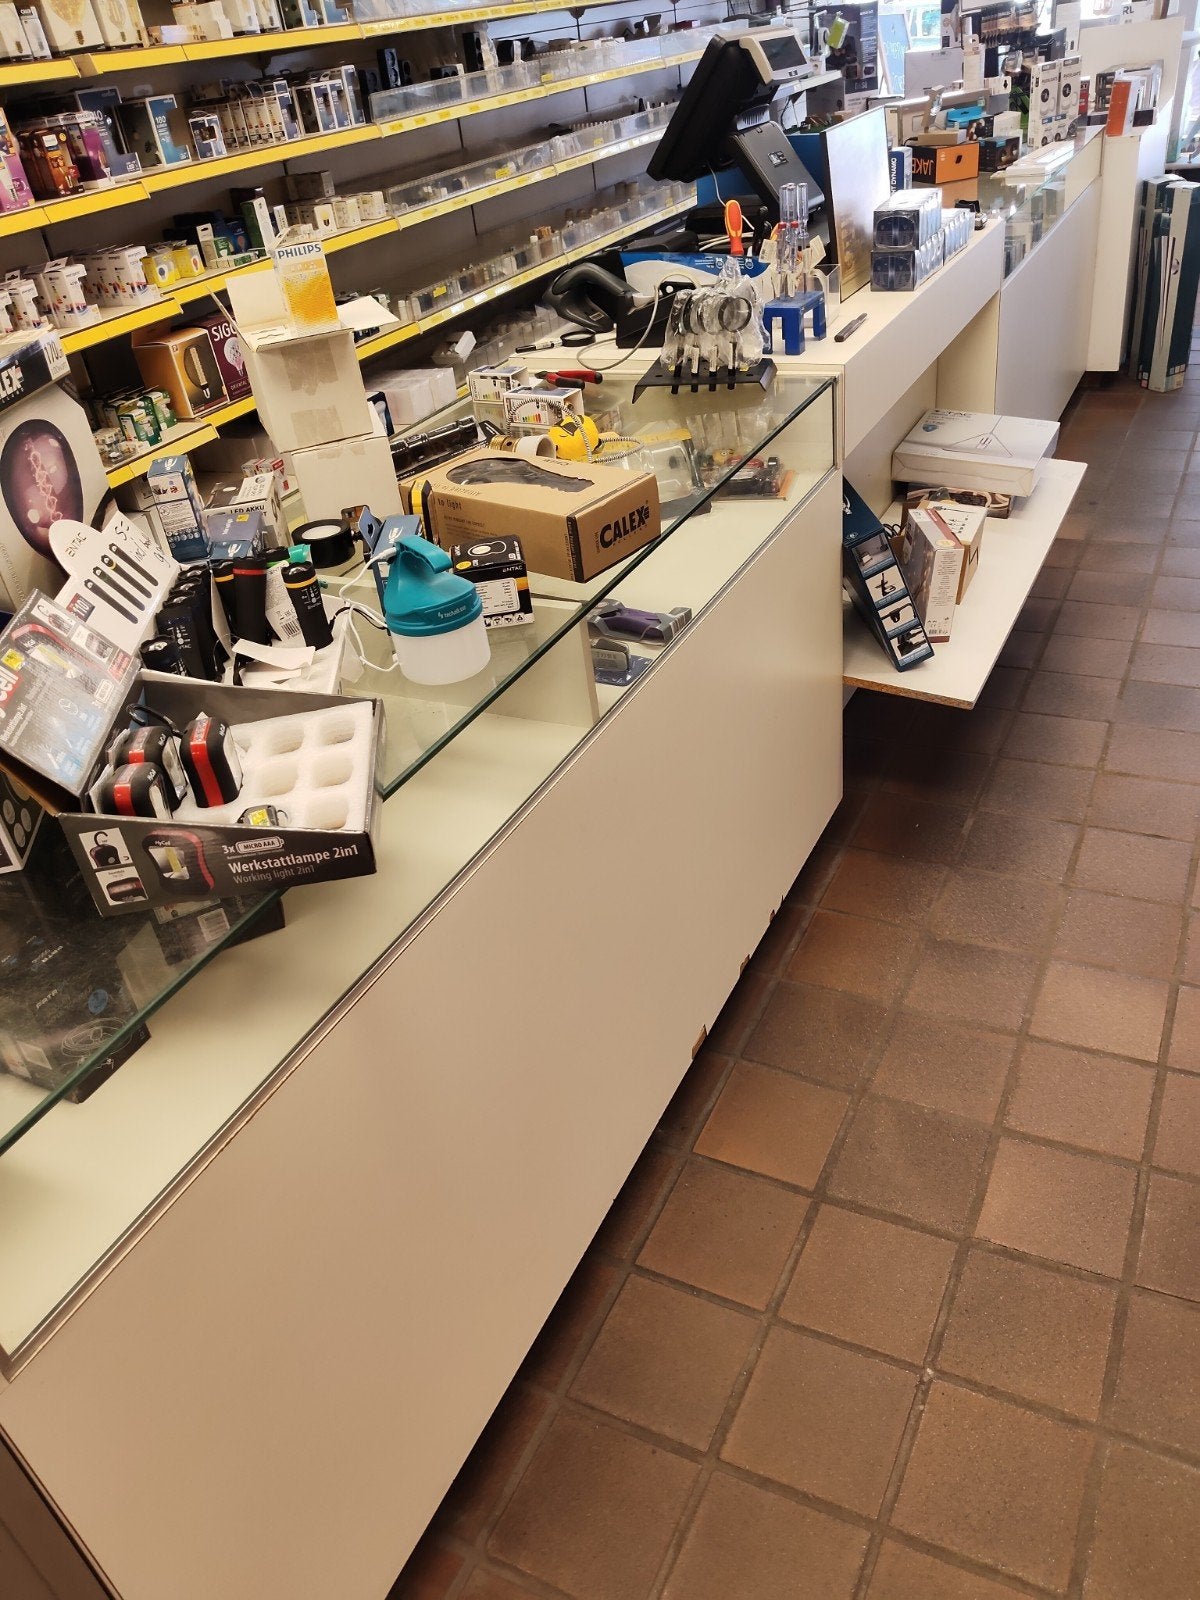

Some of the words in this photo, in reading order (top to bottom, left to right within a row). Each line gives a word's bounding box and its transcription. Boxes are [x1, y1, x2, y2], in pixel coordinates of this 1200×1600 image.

[890, 157, 898, 185] DYNAMO
[277, 243, 322, 260] PHILIPS
[600, 505, 648, 549] CALEX
[222, 844, 236, 854] 3x
[243, 842, 262, 850] MICRO
[263, 840, 276, 848] AAA
[228, 851, 330, 874] Werkstattlampe
[332, 844, 359, 859] 2in1
[233, 870, 272, 885] Working
[274, 867, 295, 880] light
[297, 864, 316, 875] 2in1
